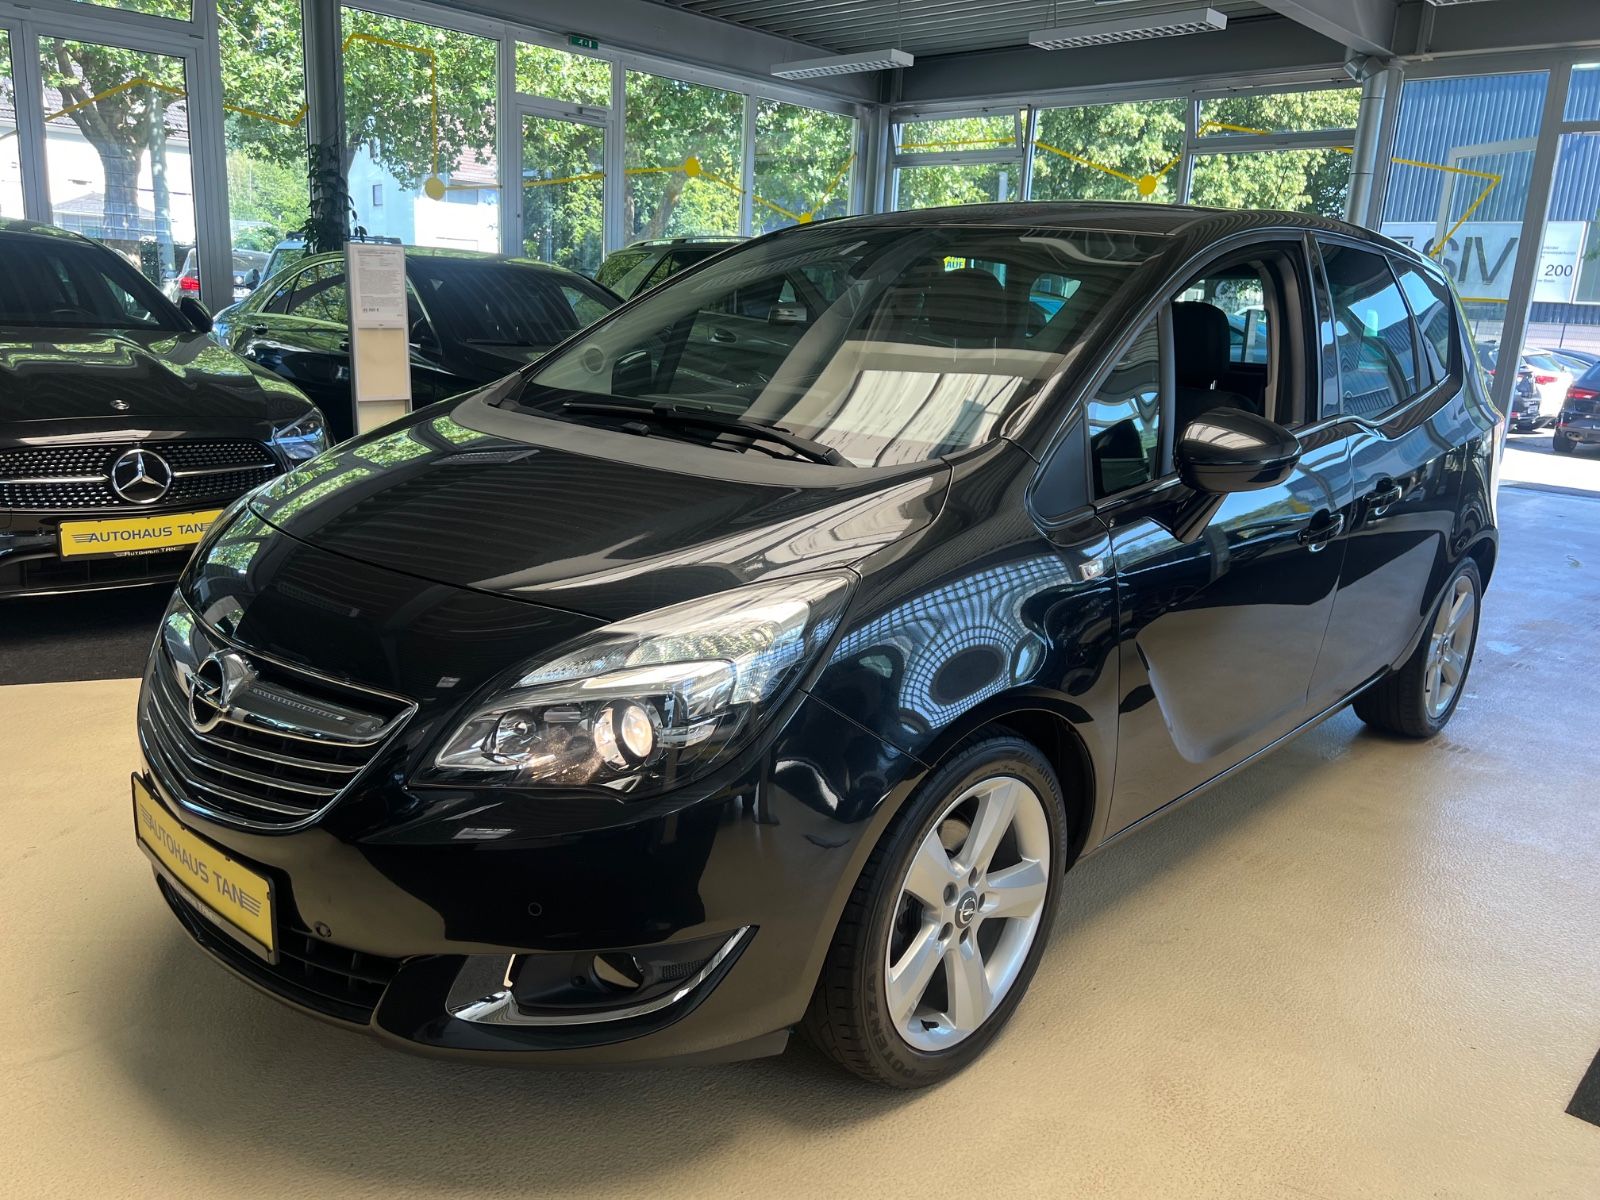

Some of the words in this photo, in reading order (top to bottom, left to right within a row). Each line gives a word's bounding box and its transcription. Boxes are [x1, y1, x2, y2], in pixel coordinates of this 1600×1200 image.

[1544, 264, 1573, 277] 200
[89, 526, 172, 543] AUTOHAUS
[178, 523, 204, 535] TAN
[149, 814, 209, 884] AUTOHAUS
[212, 871, 245, 909] TAN
[867, 974, 917, 1079] POTENZA
